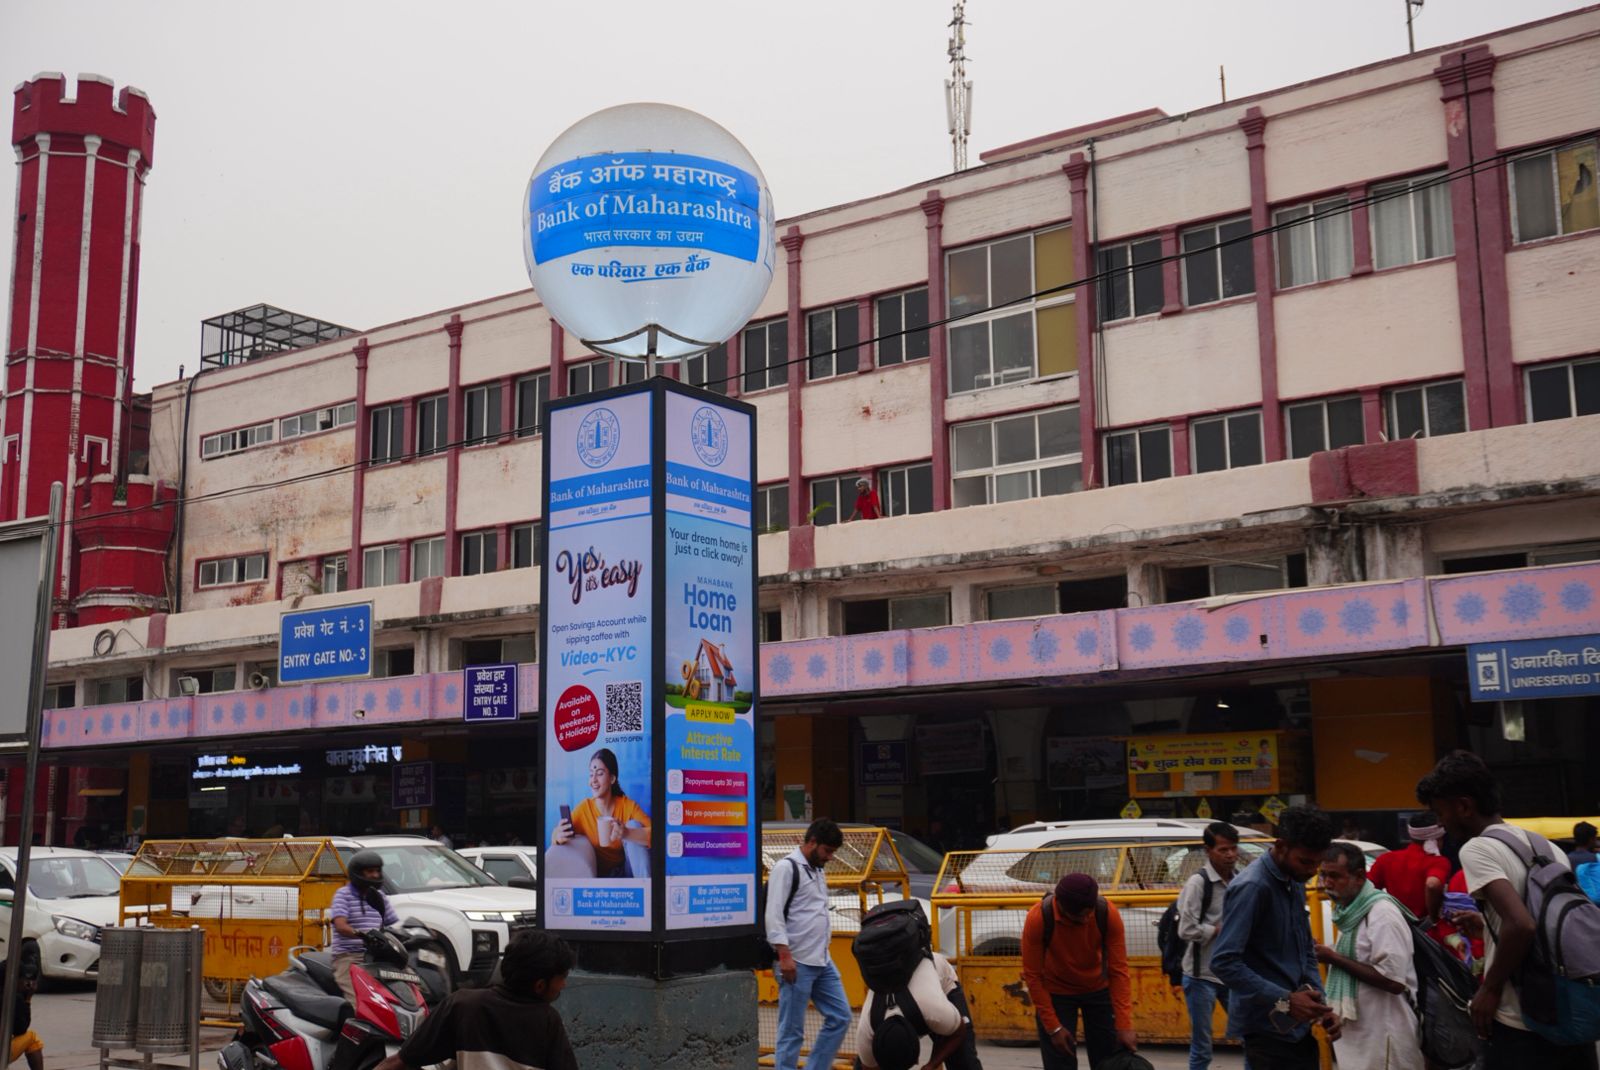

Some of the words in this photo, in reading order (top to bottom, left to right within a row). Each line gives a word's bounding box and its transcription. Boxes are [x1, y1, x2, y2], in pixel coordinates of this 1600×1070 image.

[549, 169, 583, 193] बैंक
[589, 159, 647, 184] ऑफ
[652, 164, 737, 199] महाराष्ट्र
[537, 200, 580, 233] Bank
[585, 195, 609, 217] of
[613, 193, 752, 229] Maharashtra
[584, 229, 611, 243] भारत
[613, 229, 652, 242] सरकार
[656, 230, 671, 241] का
[676, 230, 703, 243] उद्यम
[571, 262, 594, 276] एक
[598, 260, 647, 279] परिवार
[654, 262, 681, 277] एक
[685, 254, 712, 273] बैंक
[551, 491, 573, 503] Bank
[575, 486, 585, 499] of
[587, 478, 650, 497] Maharashtra
[666, 471, 689, 489] Bank
[690, 477, 699, 492] of
[701, 480, 750, 503] Maharashtra
[669, 527, 688, 541] Your
[691, 531, 718, 546] dream
[719, 536, 741, 551] home
[741, 542, 748, 553] is
[674, 543, 692, 556] just
[693, 547, 699, 556] a
[701, 547, 719, 561] click
[720, 552, 744, 567] away!
[601, 557, 642, 598] easy
[697, 576, 734, 590] MAHABANK
[683, 582, 737, 612] Home
[294, 620, 315, 639] प्रवेश
[320, 618, 335, 636] गेट
[358, 619, 364, 632] 3
[552, 623, 569, 634] Open
[570, 620, 596, 634] Savings
[596, 617, 626, 628] Account
[627, 615, 647, 624] while
[689, 606, 732, 633] Loan
[566, 633, 590, 645] sipping
[591, 630, 613, 642] coffee
[614, 629, 630, 639] with
[283, 653, 311, 669] ENTRY
[313, 650, 336, 666] GATE
[360, 647, 366, 661] 3
[560, 645, 637, 667] Video-KYC
[1510, 649, 1580, 670] अनारक्षित
[1582, 647, 1600, 665] टि
[502, 683, 508, 693] 3
[1512, 673, 1591, 688] UNRESERVED
[473, 696, 491, 706] ENTRY
[492, 695, 508, 705] GATE
[559, 693, 592, 711] Available
[493, 706, 498, 716] 3
[571, 708, 580, 717] on
[691, 709, 712, 720] APPLY
[713, 710, 731, 721] NOW
[559, 715, 595, 731] weekends
[559, 733, 564, 741] &
[565, 722, 598, 740] Holidays!
[686, 731, 733, 747] Attractive
[681, 746, 719, 761] Interest
[720, 748, 741, 762] Rate
[1209, 757, 1227, 765] का
[1232, 756, 1251, 764] रस
[685, 778, 714, 787] Repayment
[714, 779, 725, 787] upto
[733, 780, 745, 788] years
[685, 841, 706, 849] Minimal
[706, 841, 742, 849] Documentation
[577, 900, 592, 908] Bank
[593, 900, 600, 908] of
[601, 900, 640, 908] Maharashtra
